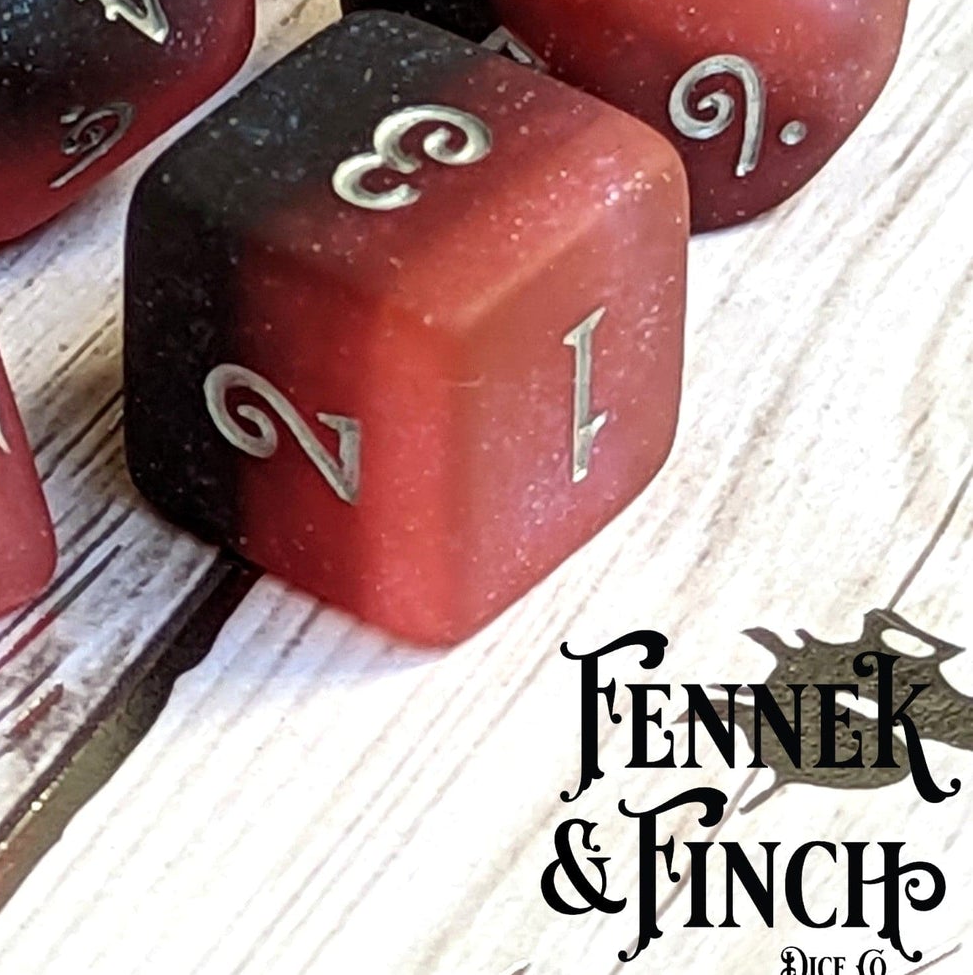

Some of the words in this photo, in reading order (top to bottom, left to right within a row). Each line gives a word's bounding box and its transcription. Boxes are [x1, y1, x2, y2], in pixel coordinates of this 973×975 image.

[332, 104, 493, 211] 3
[202, 363, 361, 506] 2
[562, 306, 607, 484] 1
